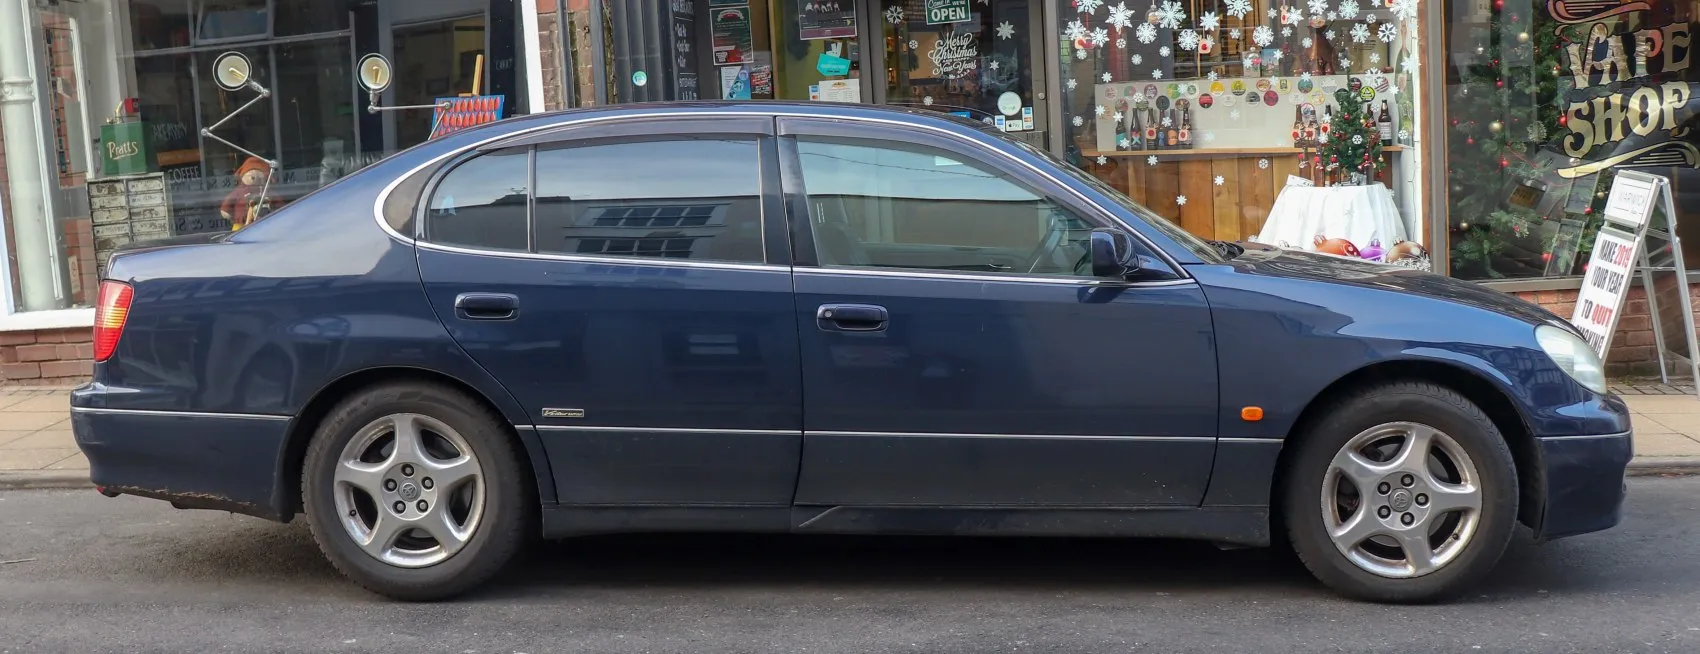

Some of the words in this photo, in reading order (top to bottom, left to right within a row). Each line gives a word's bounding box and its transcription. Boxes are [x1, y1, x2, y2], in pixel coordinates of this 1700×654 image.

[931, 7, 966, 21] OPEN
[935, 31, 973, 50] Merry
[928, 45, 977, 66] Christmas
[1566, 22, 1691, 89] VAPE
[1563, 81, 1691, 158] SHOP
[107, 141, 138, 160] Pratts
[168, 166, 201, 183] COFFEE
[1597, 239, 1618, 263] MAKE
[1614, 242, 1634, 268] 2019
[1590, 267, 1607, 290] YOUR
[1606, 270, 1624, 295] YEAR
[1581, 299, 1593, 319] TO
[1591, 303, 1613, 327] QUIT
[1576, 325, 1605, 354] OKING
